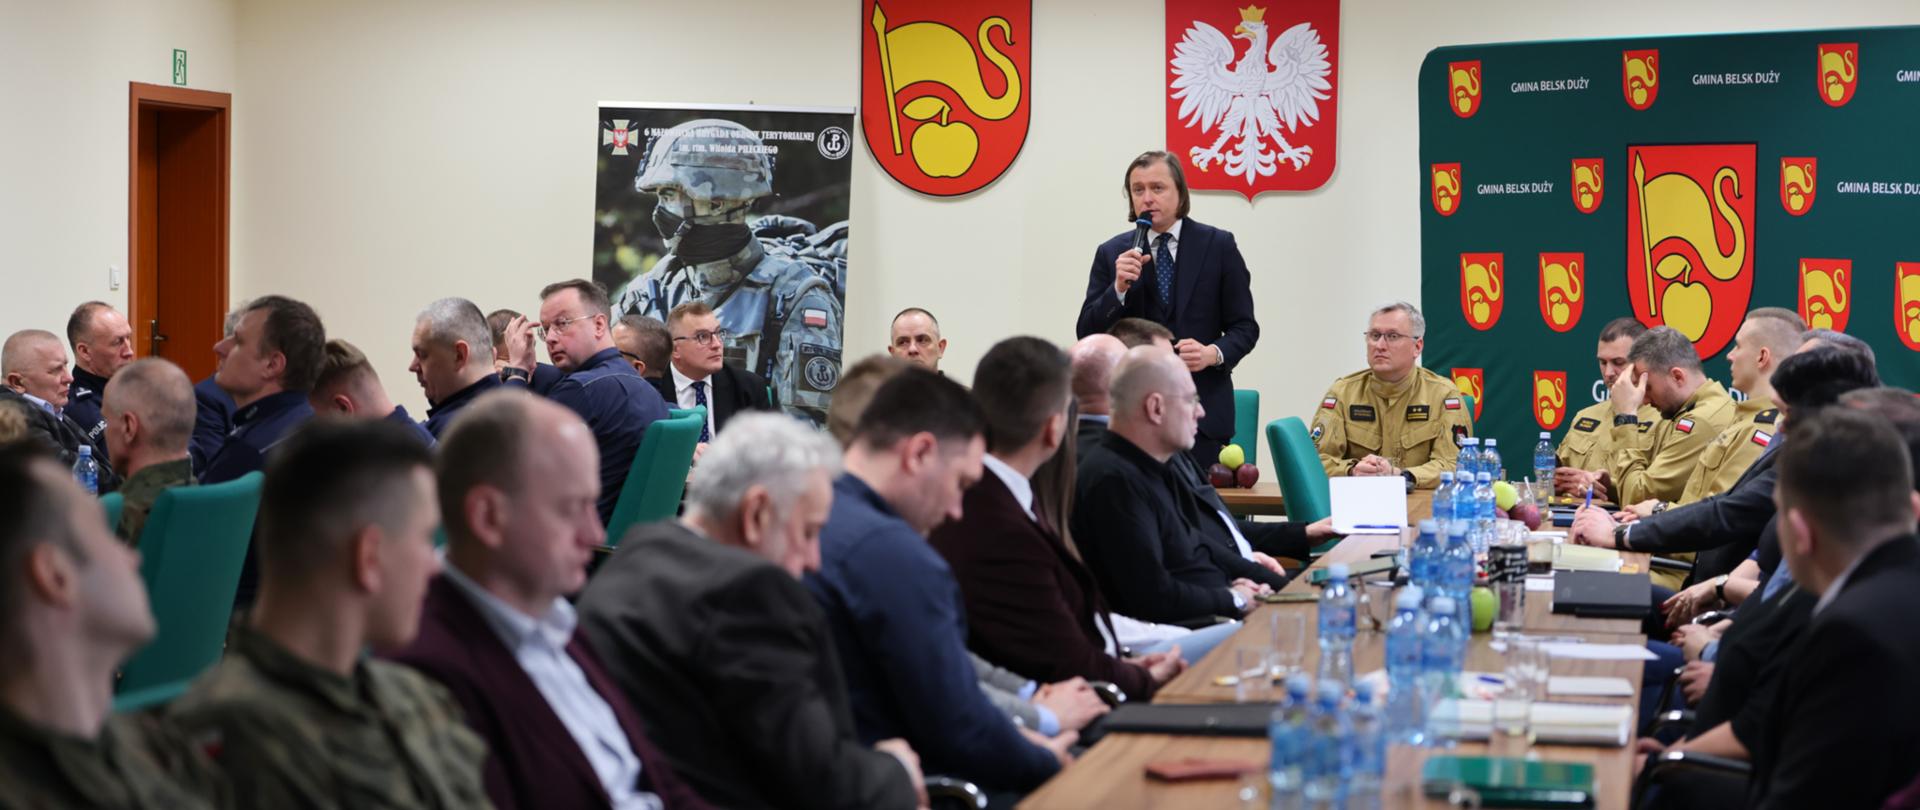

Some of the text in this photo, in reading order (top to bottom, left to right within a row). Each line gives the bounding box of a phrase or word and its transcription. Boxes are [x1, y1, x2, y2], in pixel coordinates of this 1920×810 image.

[1511, 77, 1590, 93] GMINA BELSK DUŻY
[1692, 70, 1780, 85] GMINA BELSK DUŻY
[1477, 180, 1554, 195] GMINA BELSK DUŻY
[1837, 181, 1920, 195] GMINA BELSK DU
